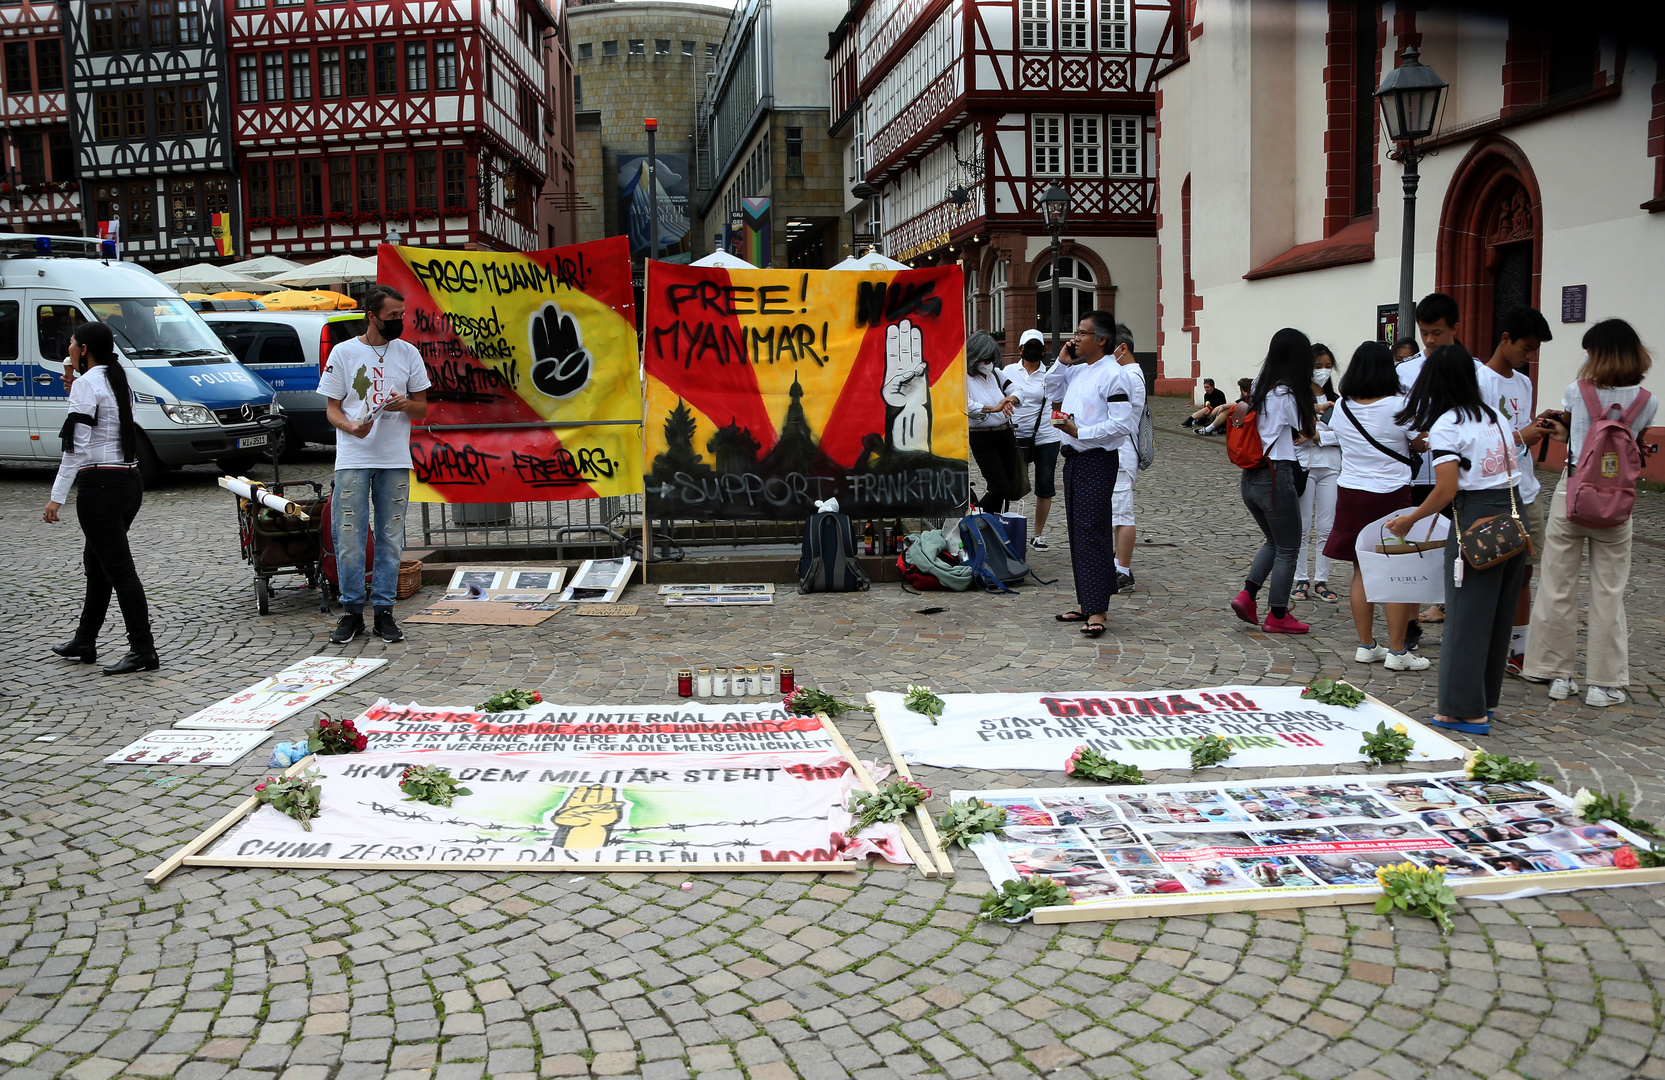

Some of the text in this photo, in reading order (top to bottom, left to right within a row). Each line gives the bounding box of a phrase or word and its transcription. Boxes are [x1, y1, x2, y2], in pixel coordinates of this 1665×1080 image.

[630, 205, 688, 214] MANETIC
[667, 272, 811, 316] FREE!
[652, 320, 830, 370] MYANMAR!
[189, 371, 252, 386] POLIZEI
[847, 468, 969, 506] FRANKFURT
[374, 709, 436, 722] THIS
[442, 713, 476, 724] IS
[481, 712, 536, 724] NOT
[537, 712, 578, 724] AN
[585, 711, 706, 724] INTERNAL
[1054, 716, 1102, 728] DIE
[394, 722, 784, 734] THIS IS A CRIME AGAINST HUMANITY
[976, 729, 1034, 742] FÜR
[1097, 724, 1210, 737] MILITÄR
[1220, 720, 1344, 735] DIKTATUR
[366, 730, 807, 744] DAS IST KEINE INNERE ANGELEGENHEIT
[1086, 738, 1123, 751] IN
[1125, 736, 1287, 752] MYAMAR
[446, 742, 566, 752] VERBRECHEN
[572, 743, 632, 752] GEGEN
[635, 744, 667, 752] DIE
[673, 739, 834, 752] MENSCHLICHKEIT
[457, 768, 530, 782] DEM
[538, 768, 672, 784] MILITÄR
[684, 767, 782, 782] STEHT
[236, 839, 334, 858] CHINA
